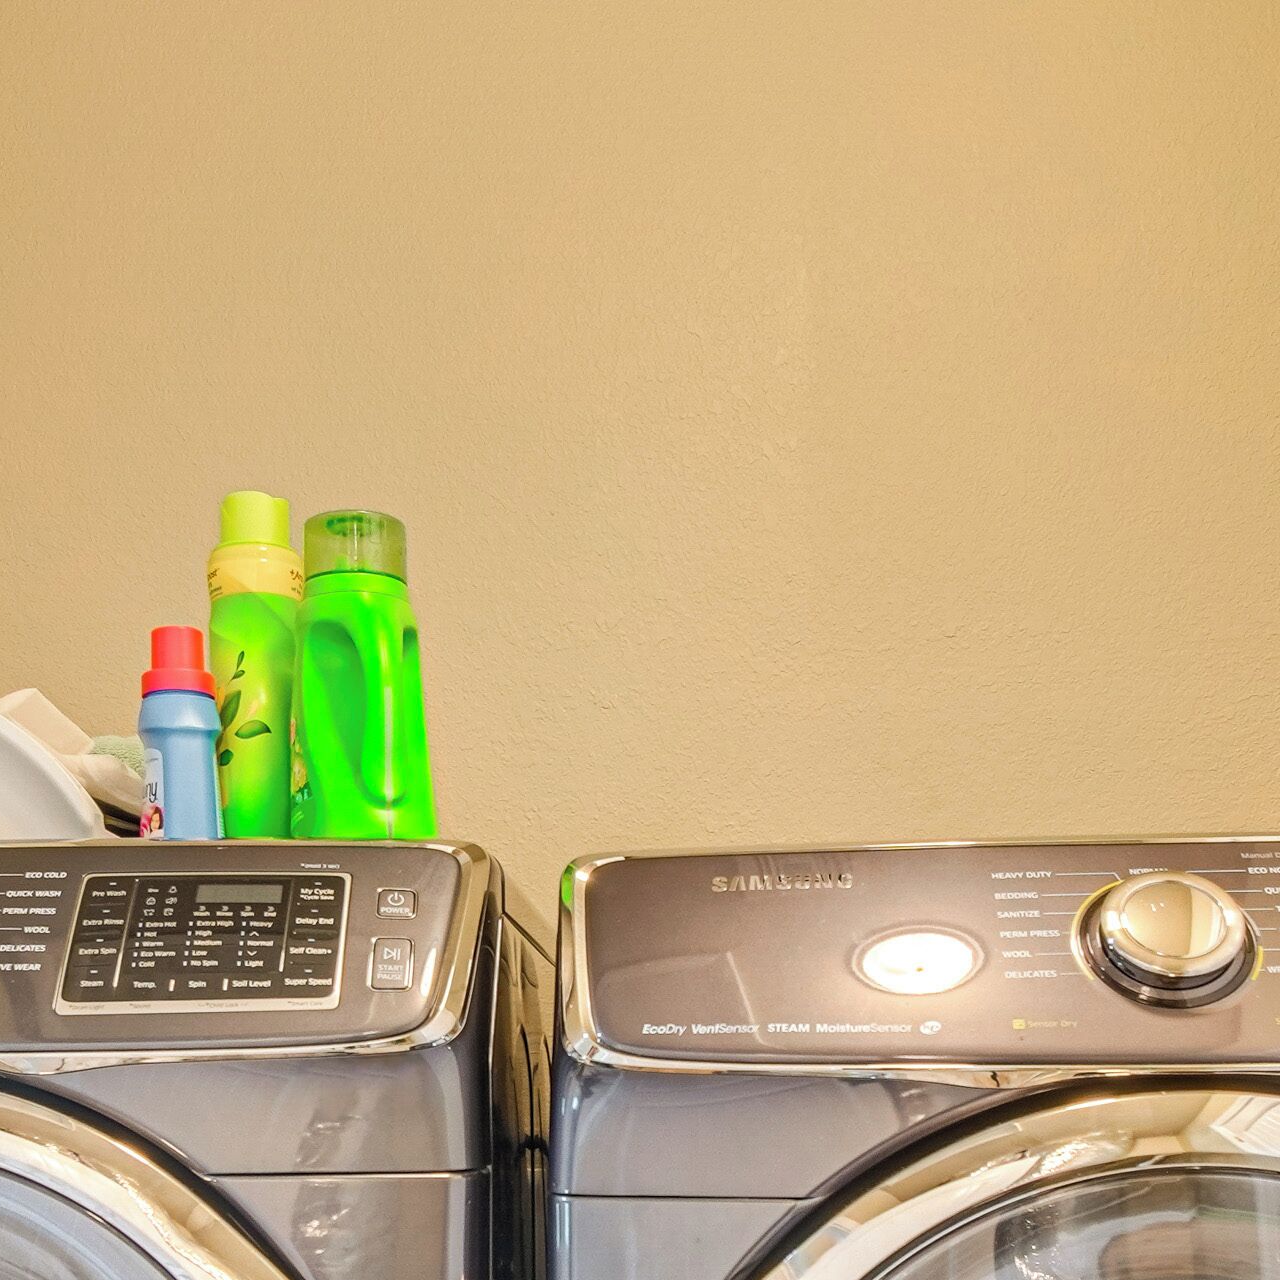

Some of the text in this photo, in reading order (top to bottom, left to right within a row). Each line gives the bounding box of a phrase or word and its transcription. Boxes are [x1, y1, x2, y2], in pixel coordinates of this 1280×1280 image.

[992, 871, 1052, 880] HEAVY DUTY
[711, 873, 853, 892] SAMSUNG
[994, 892, 1039, 900] BEDDING
[380, 906, 410, 914] POWER
[24, 926, 51, 934] WOOL
[100, 947, 117, 955] Spin
[244, 960, 264, 968] Light
[1005, 970, 1057, 978] DELICATES
[188, 980, 207, 988] Spin
[248, 980, 272, 988] Level
[285, 978, 332, 986] Super Speed
[1060, 1020, 1078, 1028] Dry
[642, 1023, 913, 1036] EcoDry VentSensor STEAM MoistureSensor
